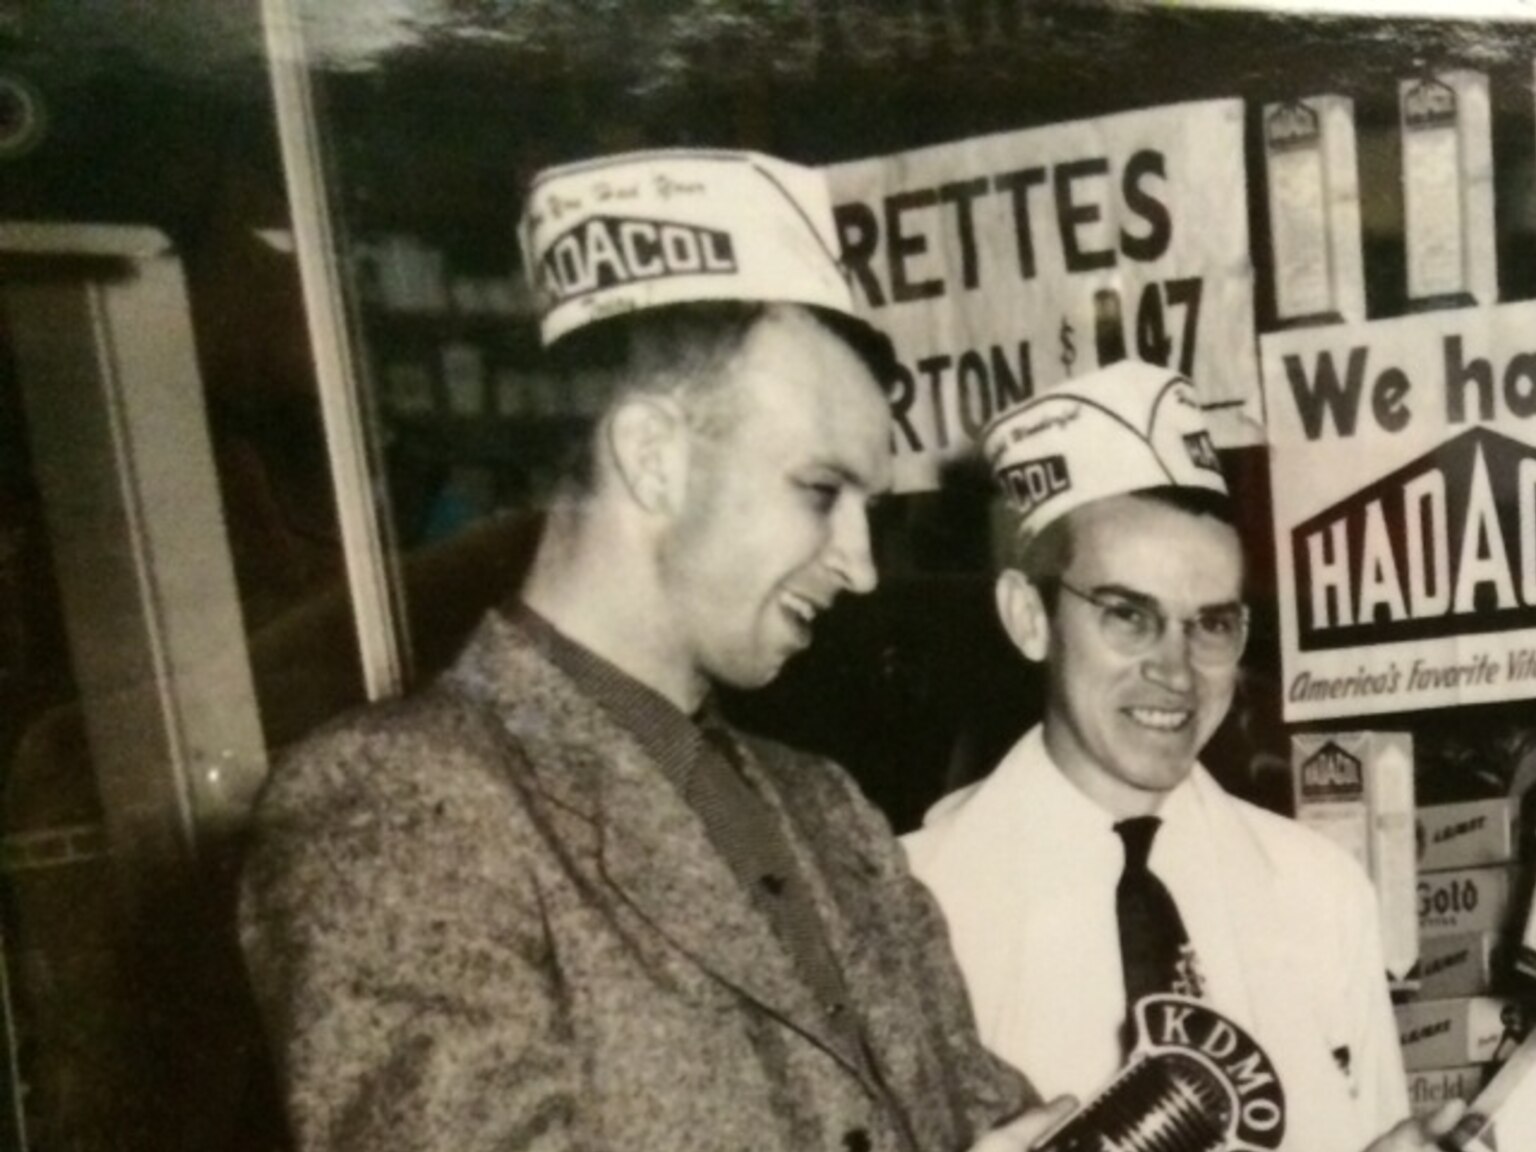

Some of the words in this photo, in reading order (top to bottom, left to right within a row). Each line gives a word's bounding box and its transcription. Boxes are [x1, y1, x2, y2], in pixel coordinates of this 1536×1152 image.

[832, 148, 1173, 308] RETTES
[1284, 345, 1412, 441] We
[1406, 653, 1499, 693] Favorite
[1161, 1005, 1281, 1132] KDMO
